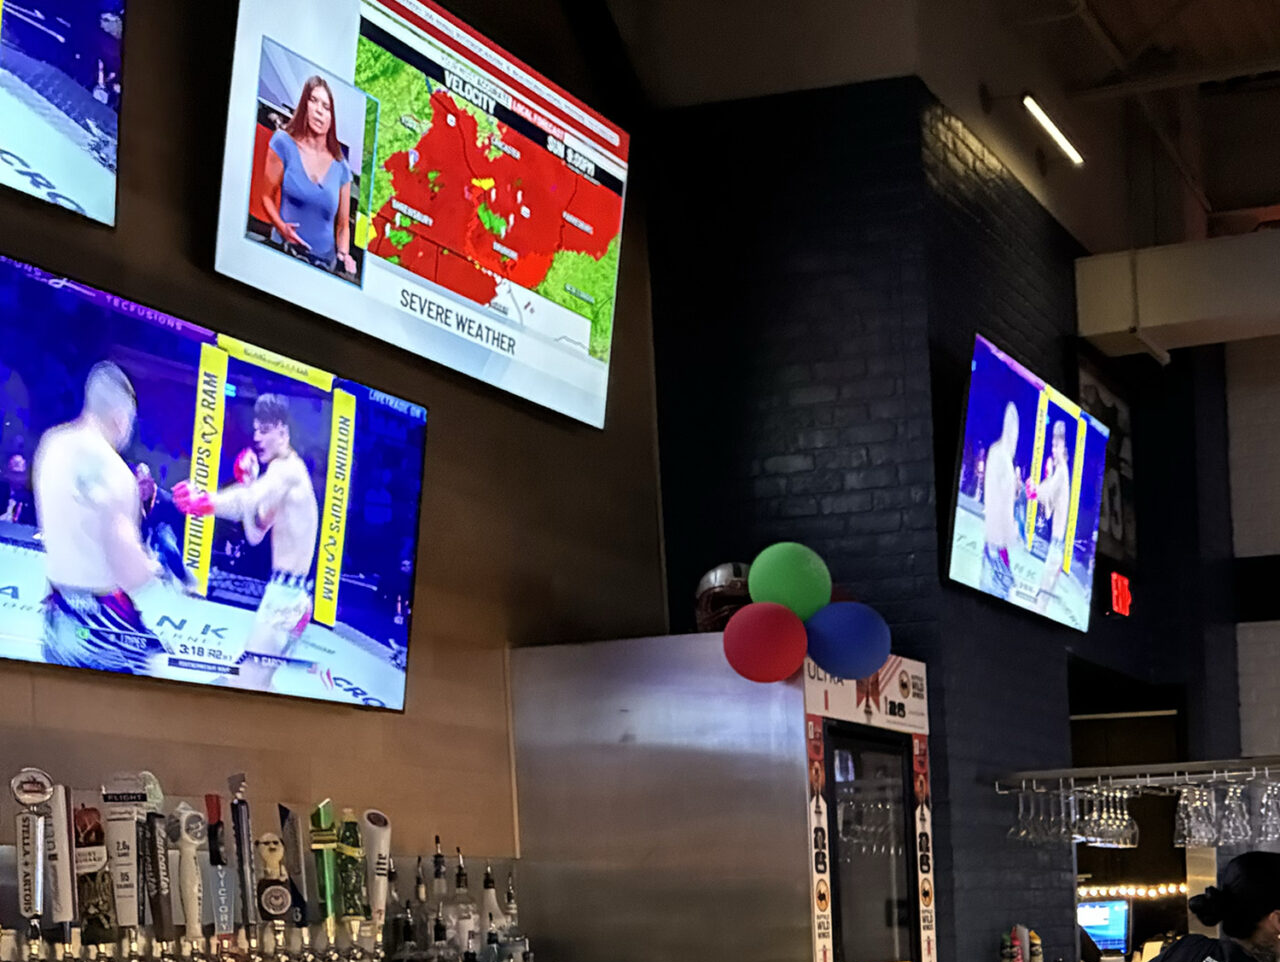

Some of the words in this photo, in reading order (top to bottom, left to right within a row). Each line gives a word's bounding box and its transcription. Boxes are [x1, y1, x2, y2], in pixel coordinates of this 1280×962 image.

[444, 69, 497, 115] VELOCITY
[400, 288, 452, 328] SEVERE
[455, 315, 516, 356] WEATHER
[202, 372, 219, 411] RAM
[334, 415, 351, 481] NOTHING
[329, 484, 346, 535] STOPS
[322, 565, 340, 602] RAM
[179, 643, 205, 657] 3:18
[21, 816, 31, 858] STELLA
[23, 870, 32, 914] ARTOIS
[216, 870, 229, 931] VICTORY
